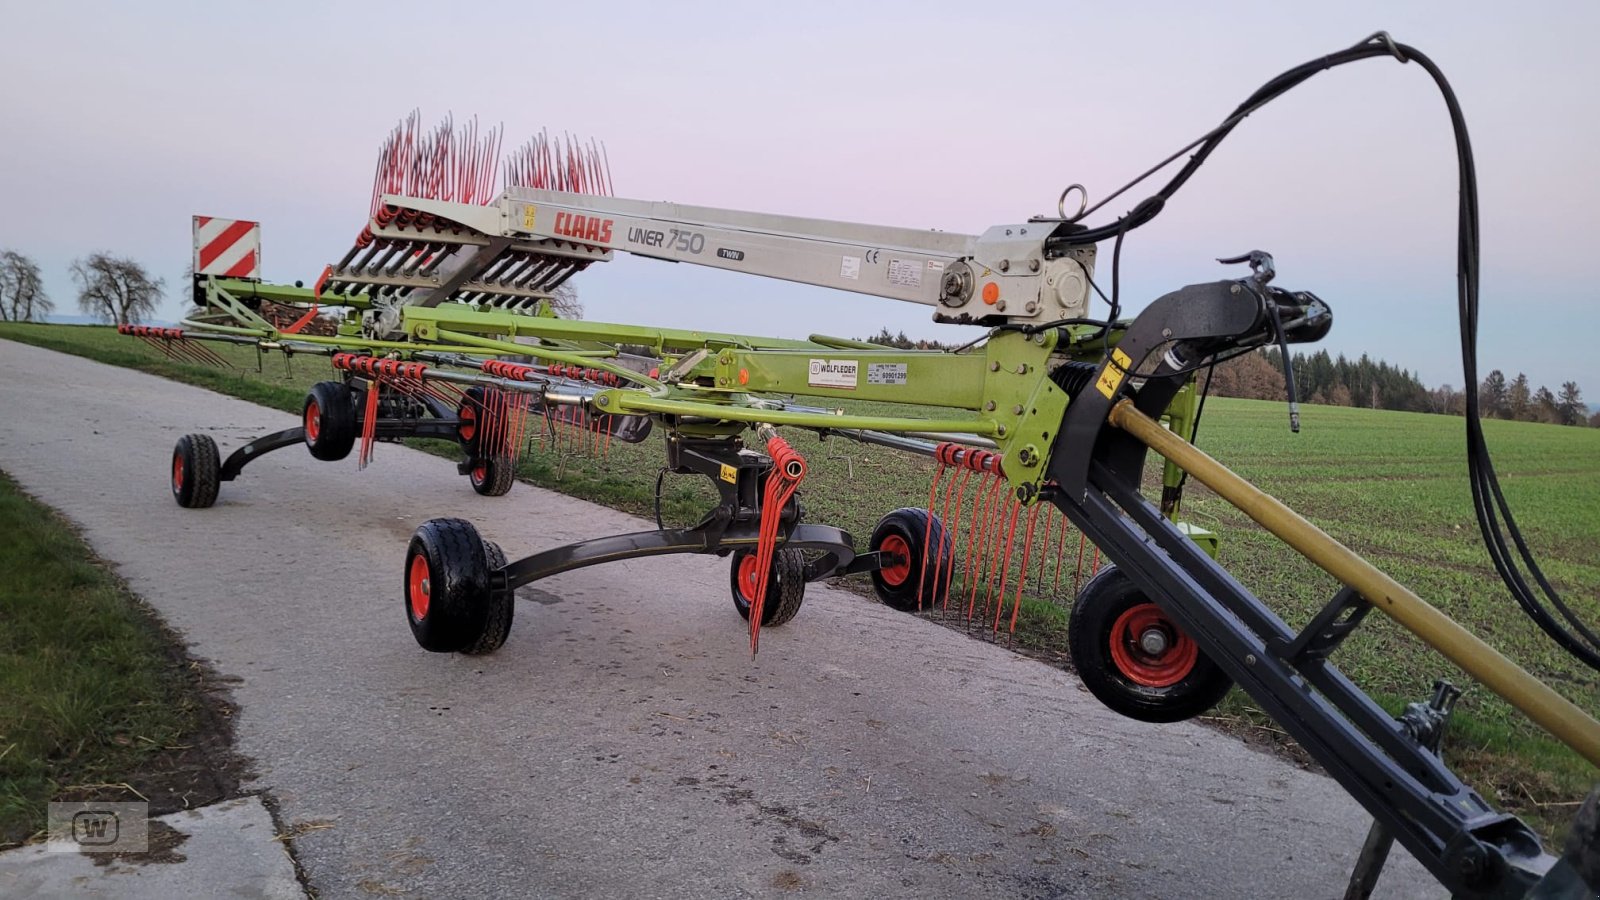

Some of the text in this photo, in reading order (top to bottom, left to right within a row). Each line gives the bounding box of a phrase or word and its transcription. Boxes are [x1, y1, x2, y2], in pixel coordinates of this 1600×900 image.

[553, 211, 614, 244] CLAAS
[627, 226, 740, 260] LINER 750 TWIN
